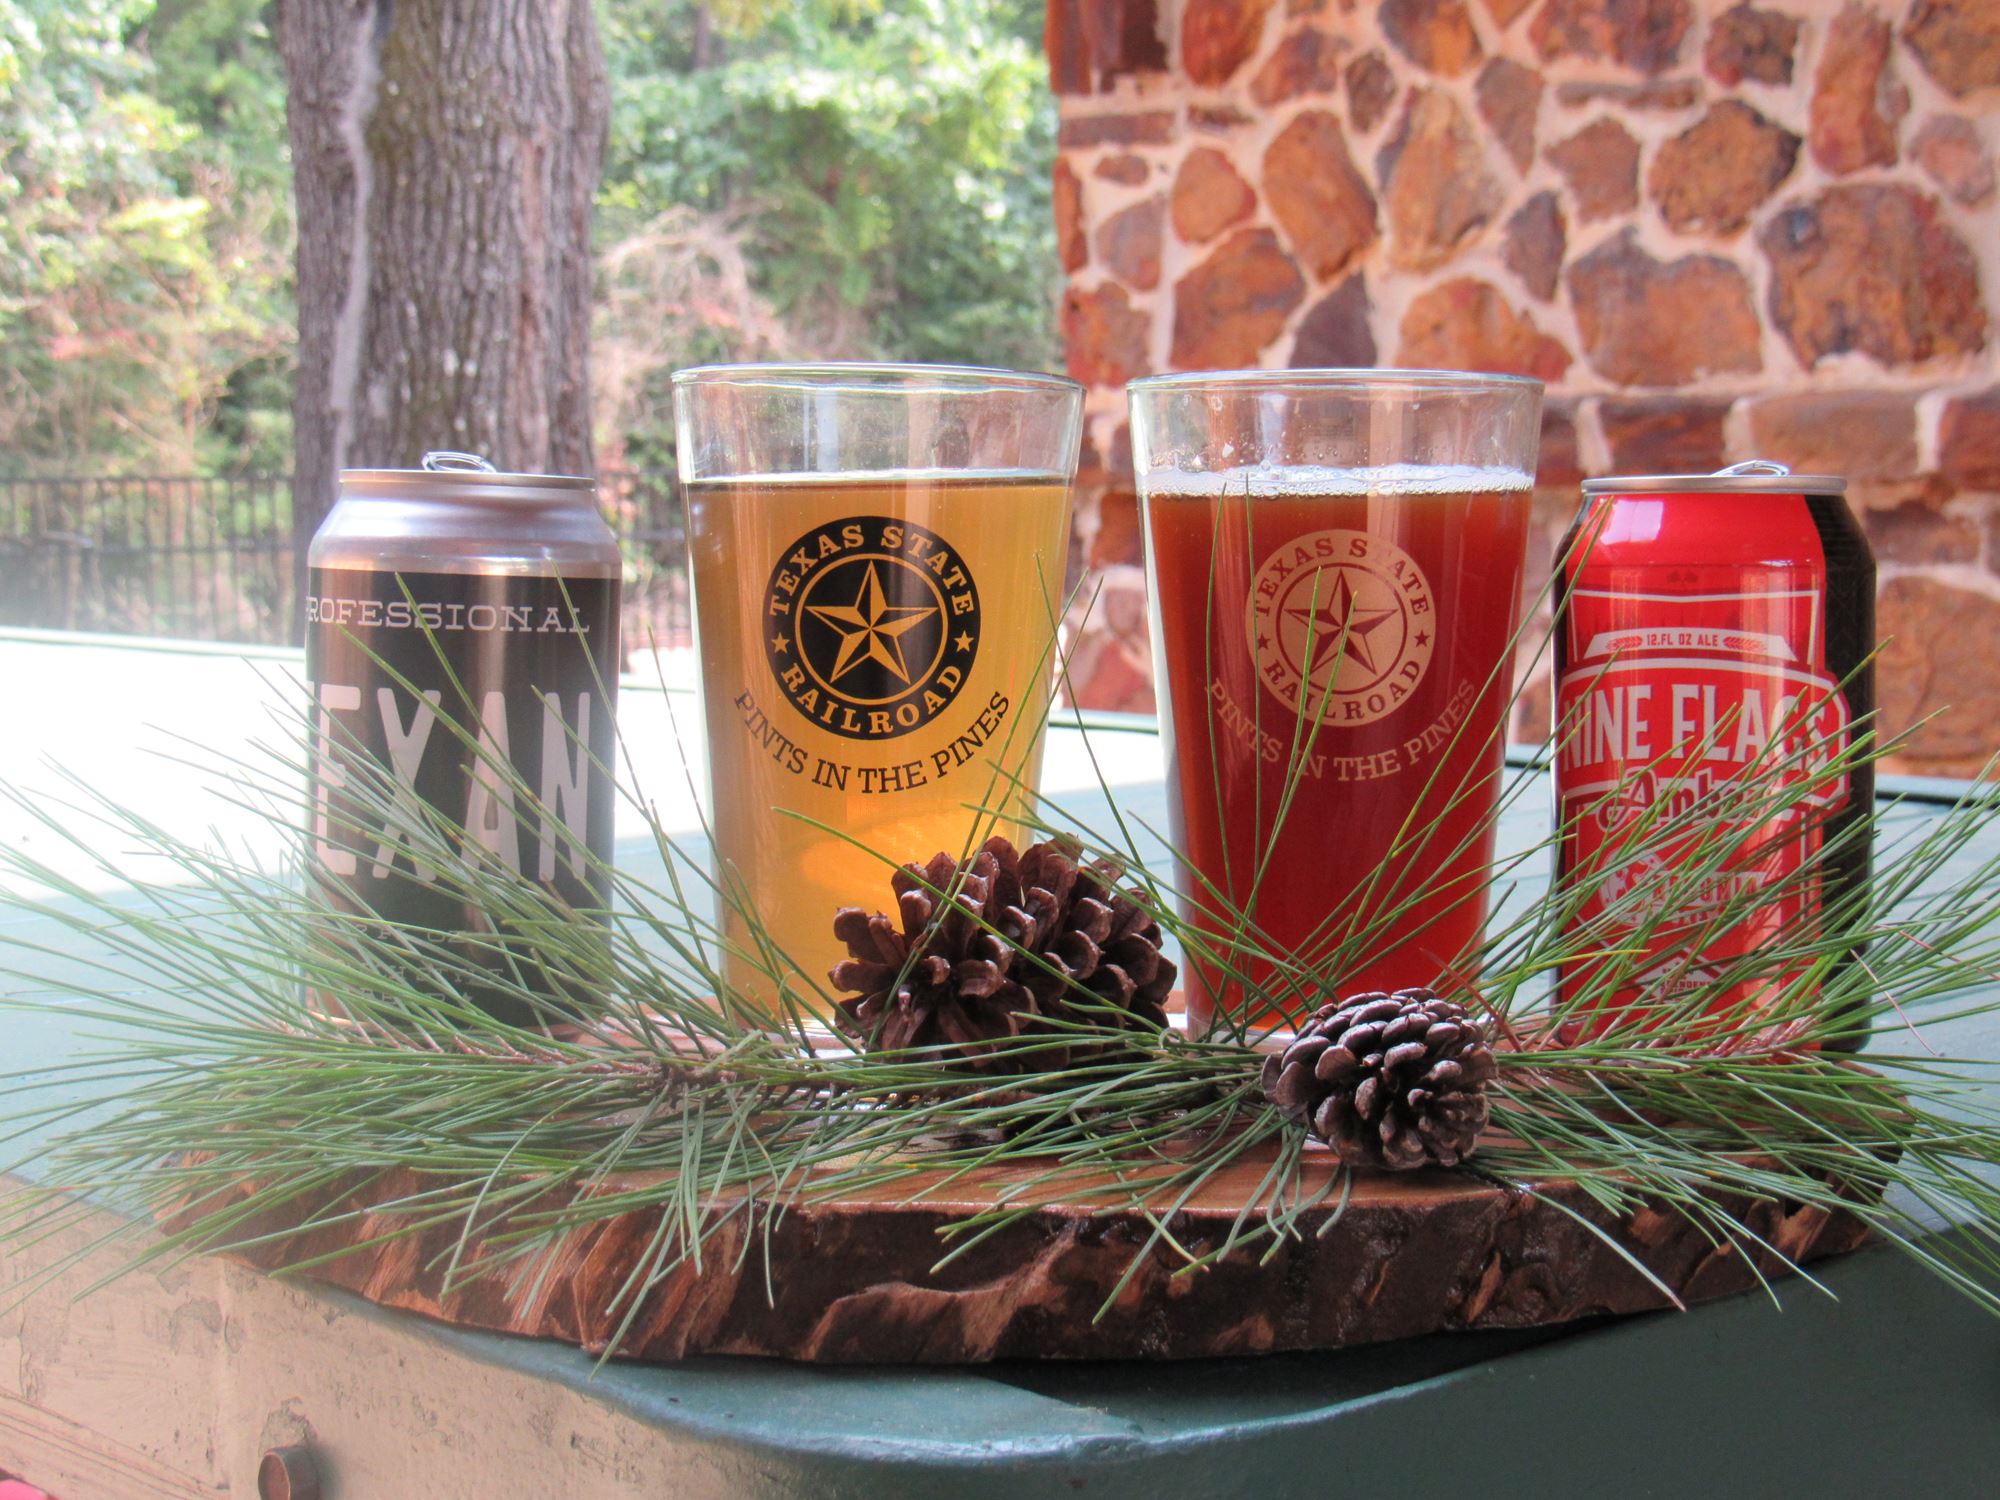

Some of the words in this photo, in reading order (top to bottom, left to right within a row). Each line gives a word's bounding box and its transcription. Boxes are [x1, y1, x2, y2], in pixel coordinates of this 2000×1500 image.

[768, 525, 864, 616] TEXAS
[881, 526, 975, 616] STATE
[1255, 537, 1334, 618] TEXAS
[1349, 538, 1430, 616] SATE
[306, 596, 590, 633] ROFESSIONAL
[1697, 634, 1719, 647] ALE
[780, 662, 963, 735] RAILROAD
[1204, 677, 1284, 763] PINTS
[1333, 750, 1401, 782] THE
[1403, 679, 1476, 767] PINES
[1264, 659, 1421, 721] RAILROAD
[1564, 684, 1652, 772] NINE
[1671, 684, 1829, 776] FLAGS
[306, 681, 591, 882] EXAN
[734, 687, 809, 775] PINTS
[811, 758, 851, 792] IN
[857, 759, 928, 794] THE
[930, 691, 1010, 778] PINES
